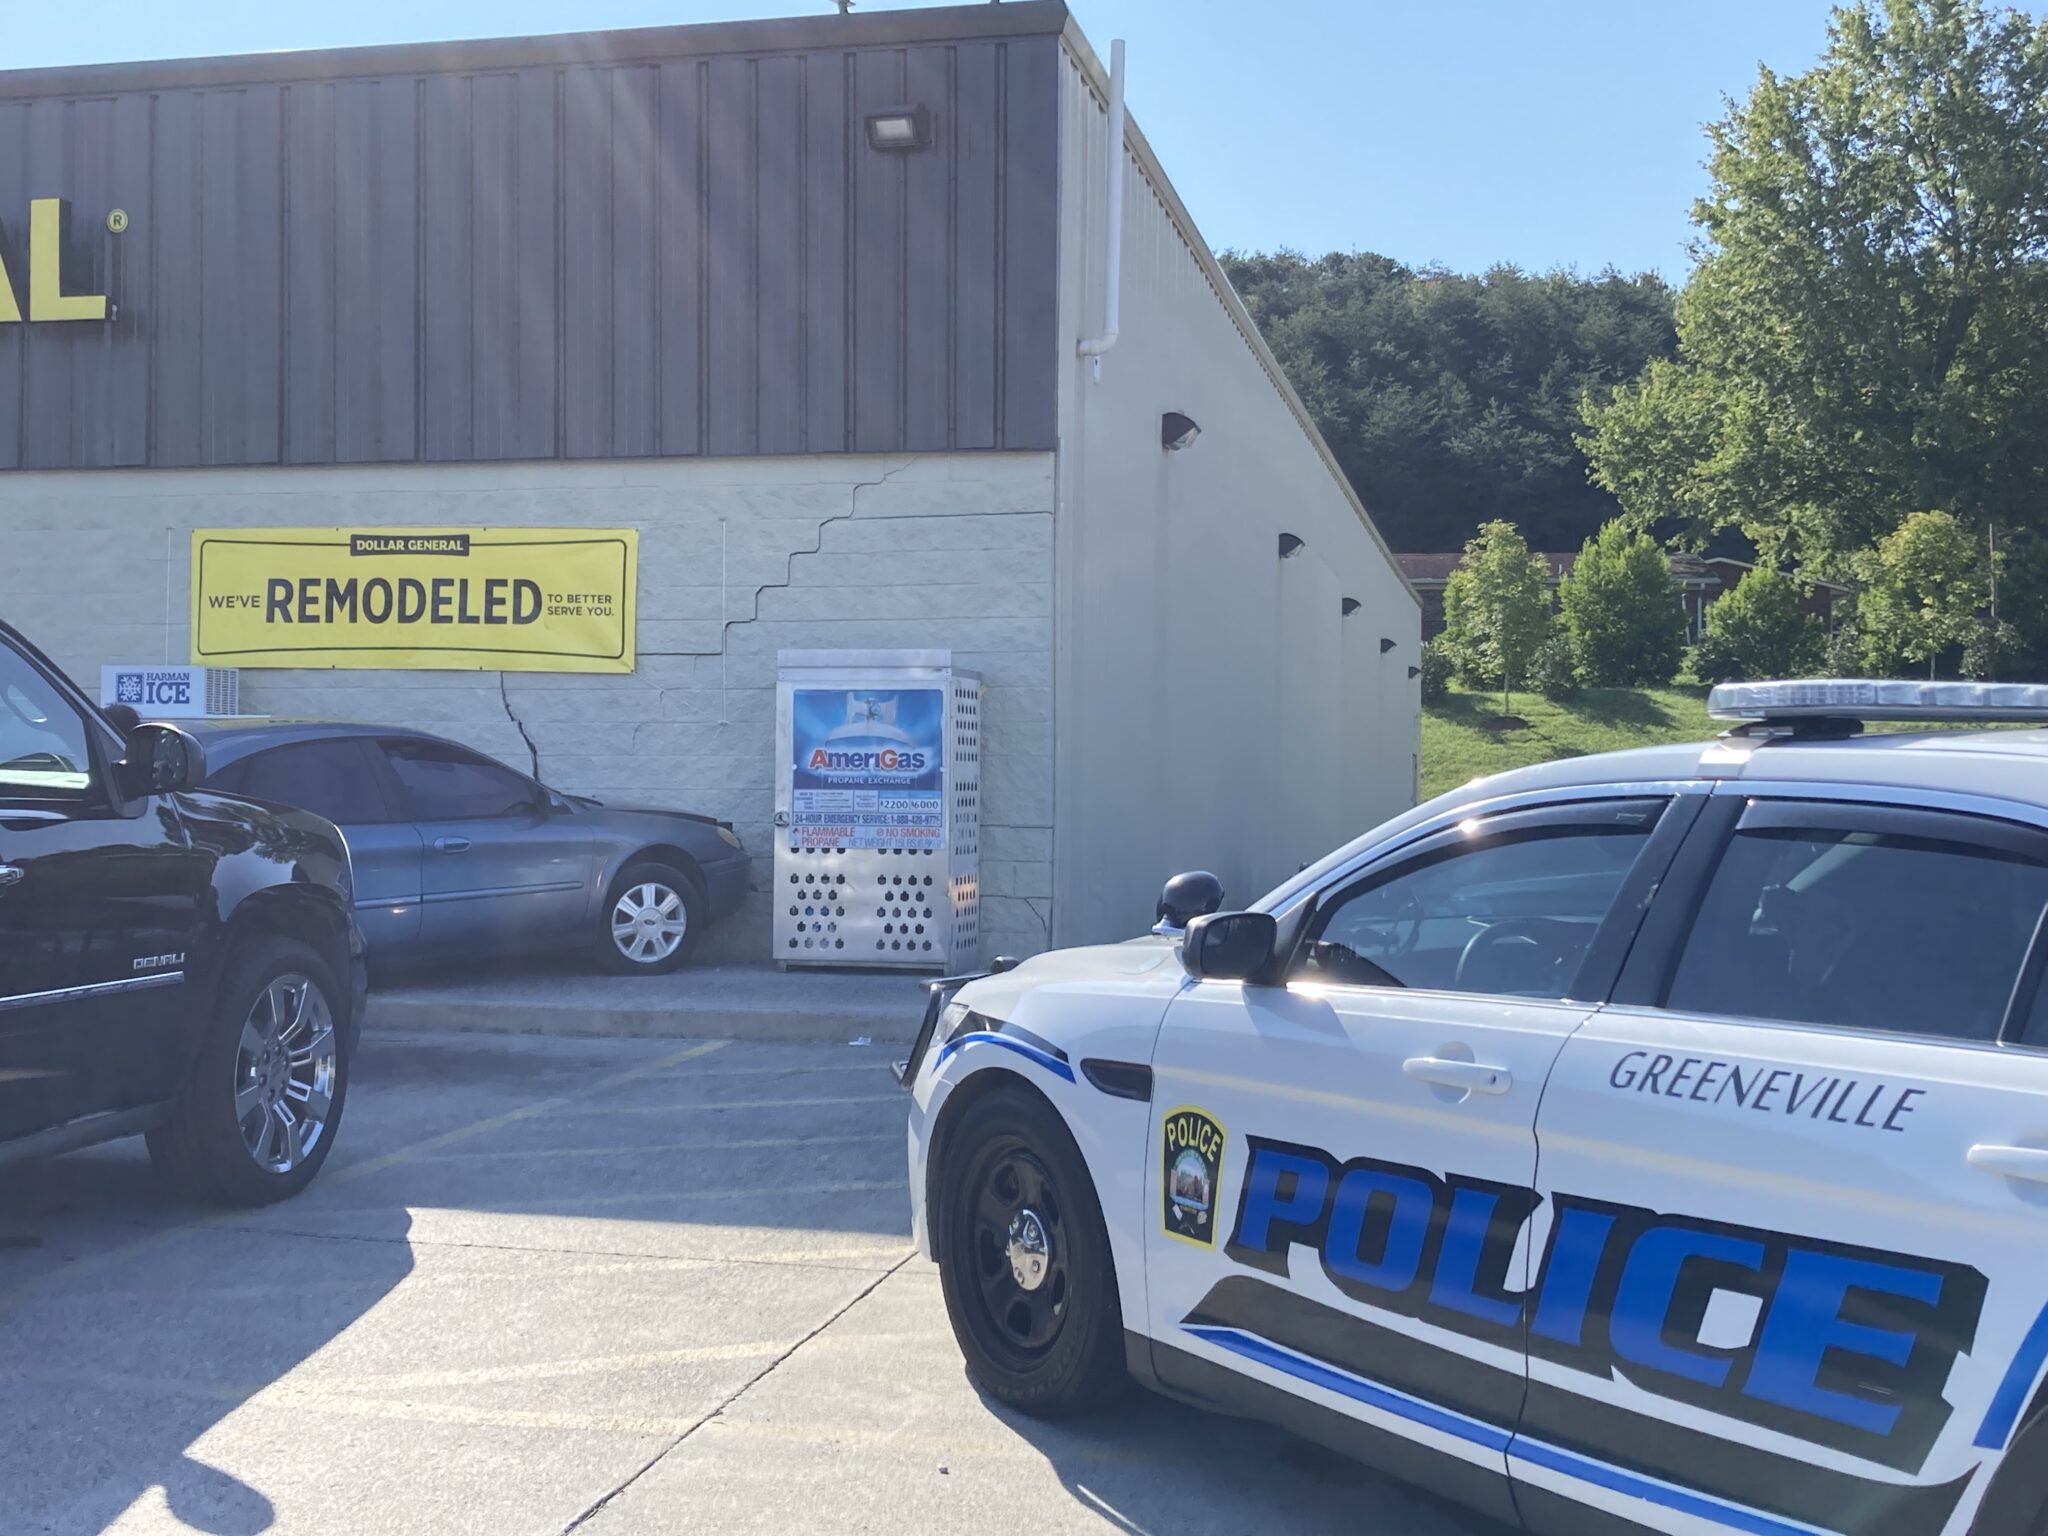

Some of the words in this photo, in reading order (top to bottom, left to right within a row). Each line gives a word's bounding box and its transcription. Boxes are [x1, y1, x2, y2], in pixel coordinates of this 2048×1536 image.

[356, 540, 405, 551] DOLLAR
[408, 540, 464, 551] GENERAL
[209, 595, 261, 608] WE'VE
[266, 578, 542, 625] REMODELED
[547, 594, 563, 603] TO
[567, 594, 612, 604] BETTER
[547, 606, 583, 616] SERVE
[587, 606, 615, 616] YOU.
[146, 672, 190, 681] HARMAN
[146, 682, 190, 704] ICE
[809, 749, 926, 770] AmeriGas
[828, 776, 865, 785] PROPANE
[868, 776, 912, 785] EXCHANGE
[794, 814, 822, 824] 24-HOUR
[824, 814, 860, 824] EMERGENCY
[801, 826, 856, 837] FLAMMABLE
[886, 827, 899, 837] NO
[900, 827, 941, 838] SMOKING
[801, 836, 840, 847] PROPANE
[133, 952, 185, 970] DENALI
[1609, 1051, 1927, 1132] GREENEVILLE
[1166, 1116, 1221, 1163] POLICE
[1236, 1145, 1950, 1440] POLICE
